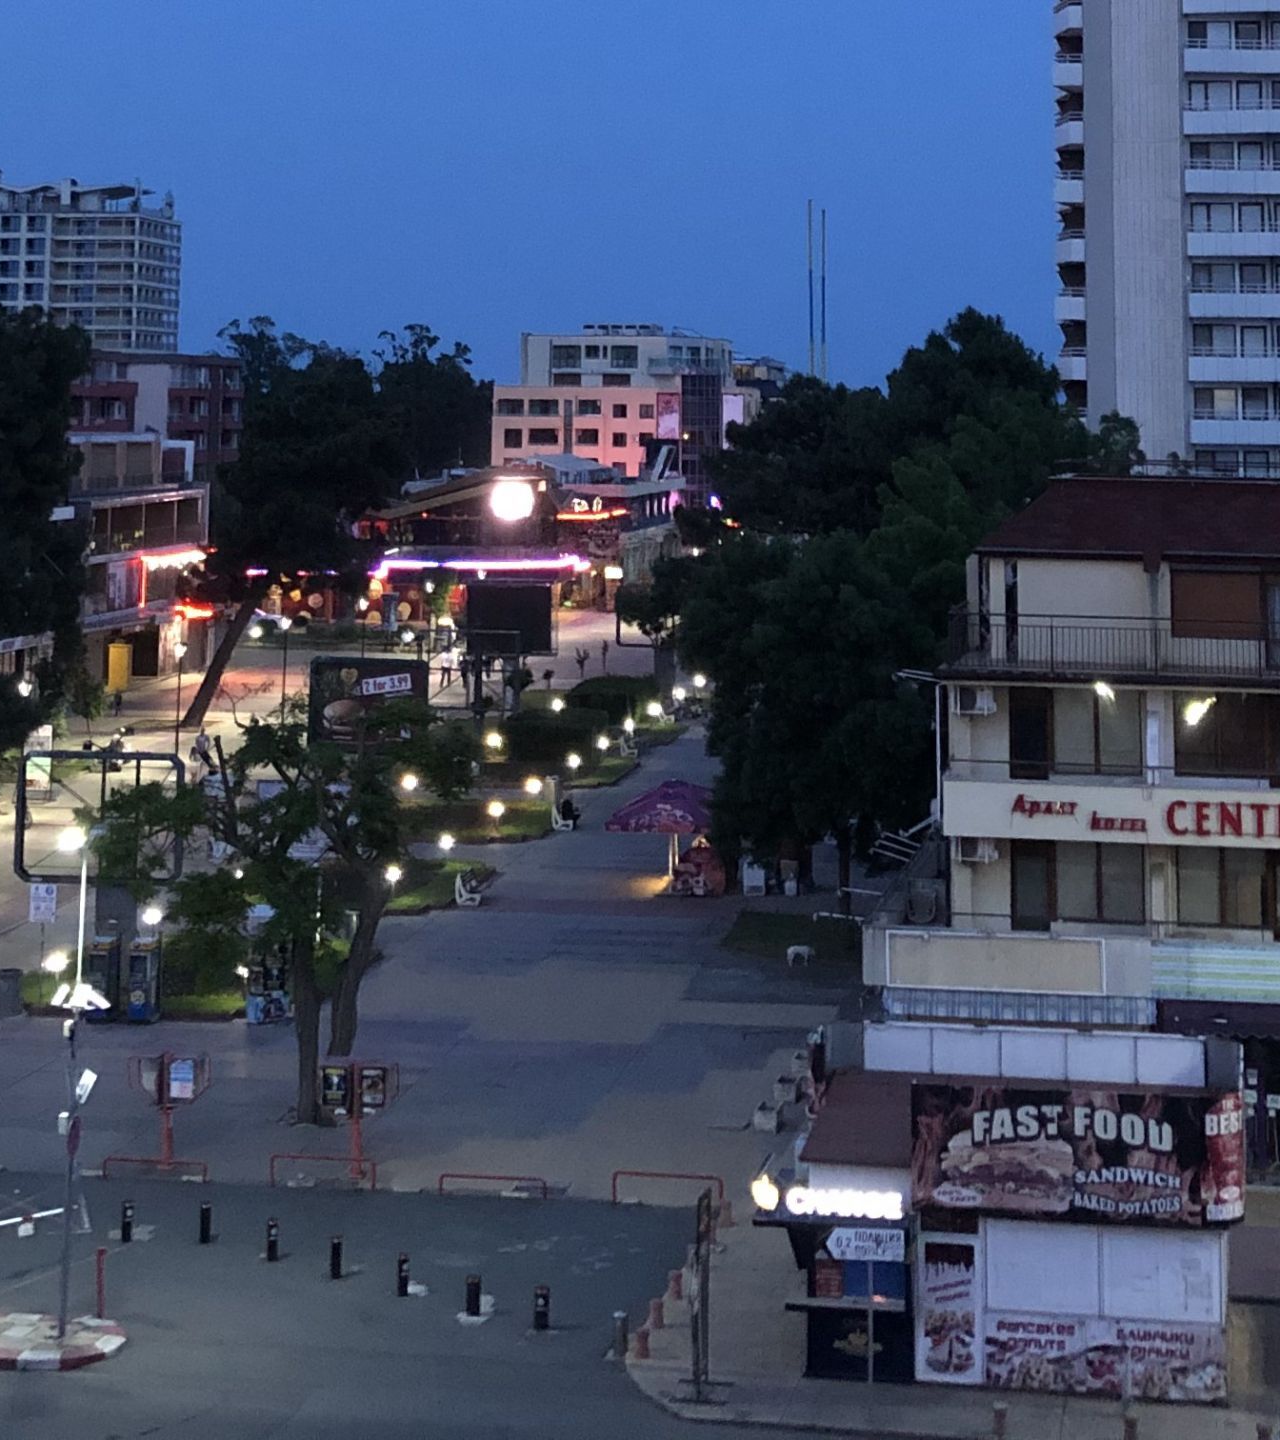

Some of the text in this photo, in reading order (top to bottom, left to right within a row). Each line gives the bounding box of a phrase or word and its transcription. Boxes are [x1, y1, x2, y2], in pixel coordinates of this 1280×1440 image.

[972, 1104, 1173, 1152] FAST FOOD
[1074, 1165, 1181, 1189] SANDWICH
[1073, 1192, 1181, 1214] BAKED POTATOES
